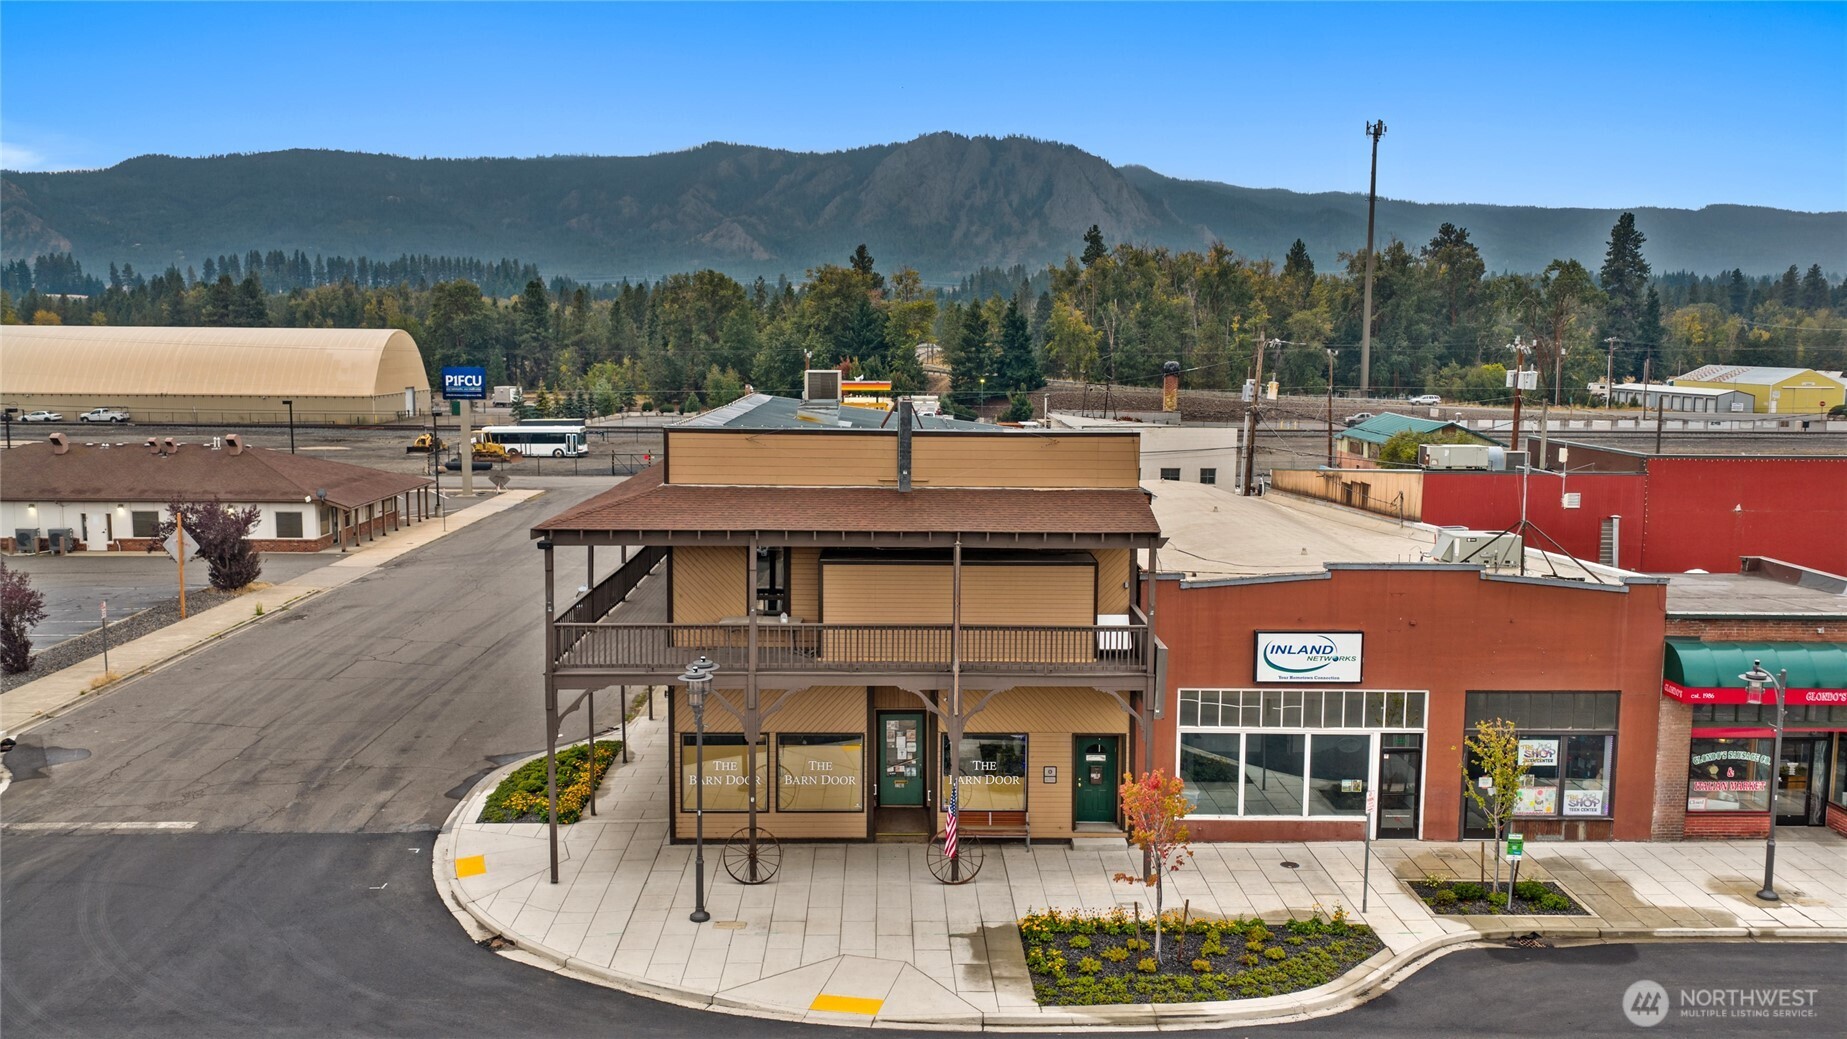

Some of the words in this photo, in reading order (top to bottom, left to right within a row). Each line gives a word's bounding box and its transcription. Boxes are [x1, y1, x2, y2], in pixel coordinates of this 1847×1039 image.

[445, 375, 482, 386] P1FCU
[1270, 645, 1334, 655] INLAND
[1805, 691, 1847, 702] GLONDO'S
[1523, 748, 1556, 758] SHOP
[1692, 751, 1728, 765] GLONDO'S
[1728, 750, 1761, 762] SAUSAGE
[713, 760, 738, 771] THE
[808, 760, 833, 771] THE
[972, 760, 997, 771] THE
[1726, 766, 1735, 778] &
[784, 774, 817, 785] BARN
[821, 774, 856, 785] DOOR
[985, 774, 1020, 785] DOOR
[1693, 780, 1728, 791] ITALIAN
[1729, 780, 1767, 791] MARKET
[1568, 797, 1601, 807] SHOP
